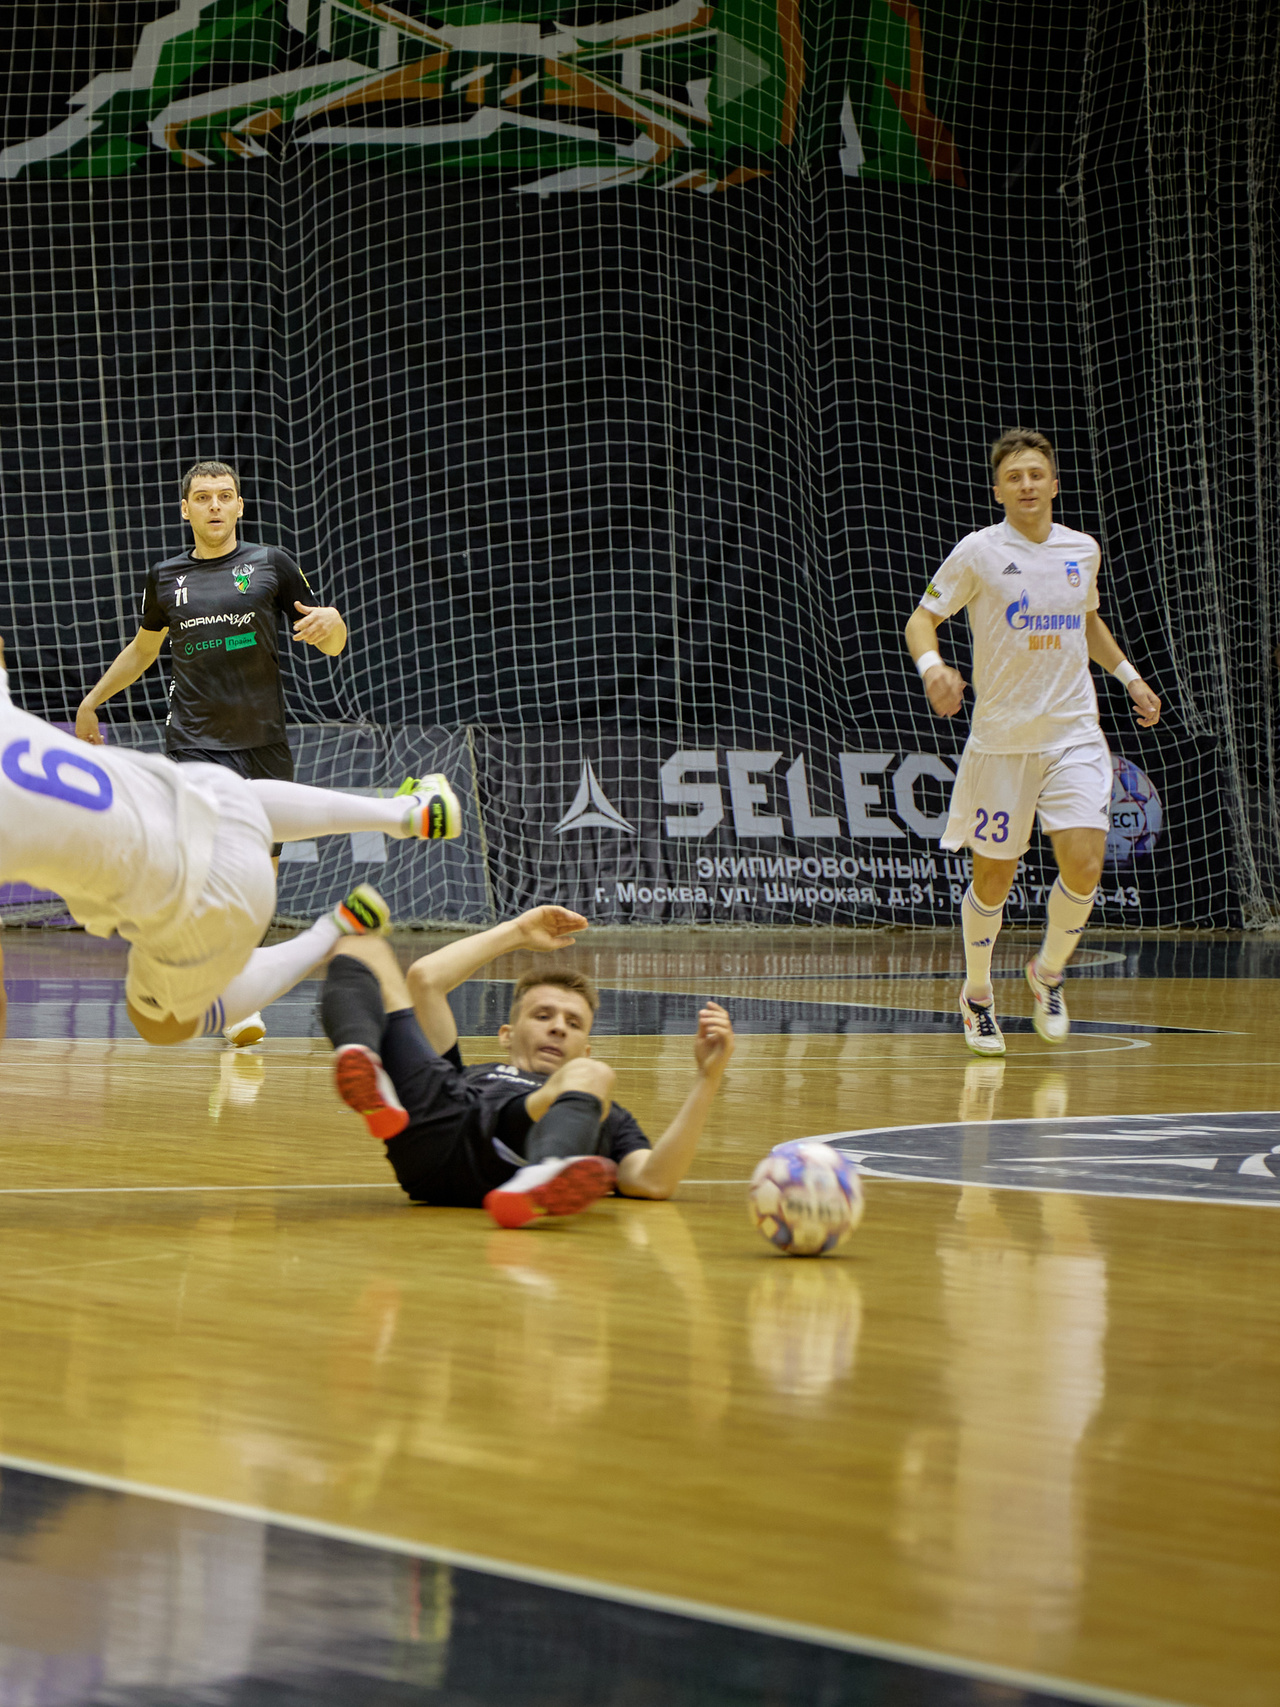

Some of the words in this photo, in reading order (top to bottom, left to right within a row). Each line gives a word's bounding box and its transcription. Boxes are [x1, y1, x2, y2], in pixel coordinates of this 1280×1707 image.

[174, 587, 189, 607] 11
[1029, 614, 1081, 630] ГАЗПРОМ
[195, 638, 223, 651] СБЕР
[1028, 635, 1062, 650] ЮГРА
[1, 739, 113, 812] 6
[660, 750, 969, 838] SELEC
[974, 808, 1010, 843] 23
[1112, 811, 1139, 829] ECT
[696, 853, 937, 879] ЭКИПИРОВОЧНЫЙ
[943, 857, 1035, 883] ЦЕР:
[595, 888, 609, 904] г.
[616, 883, 714, 905] Москва,
[720, 887, 756, 908] ул.
[765, 883, 881, 907] Широкая,
[888, 885, 943, 908] д.31,
